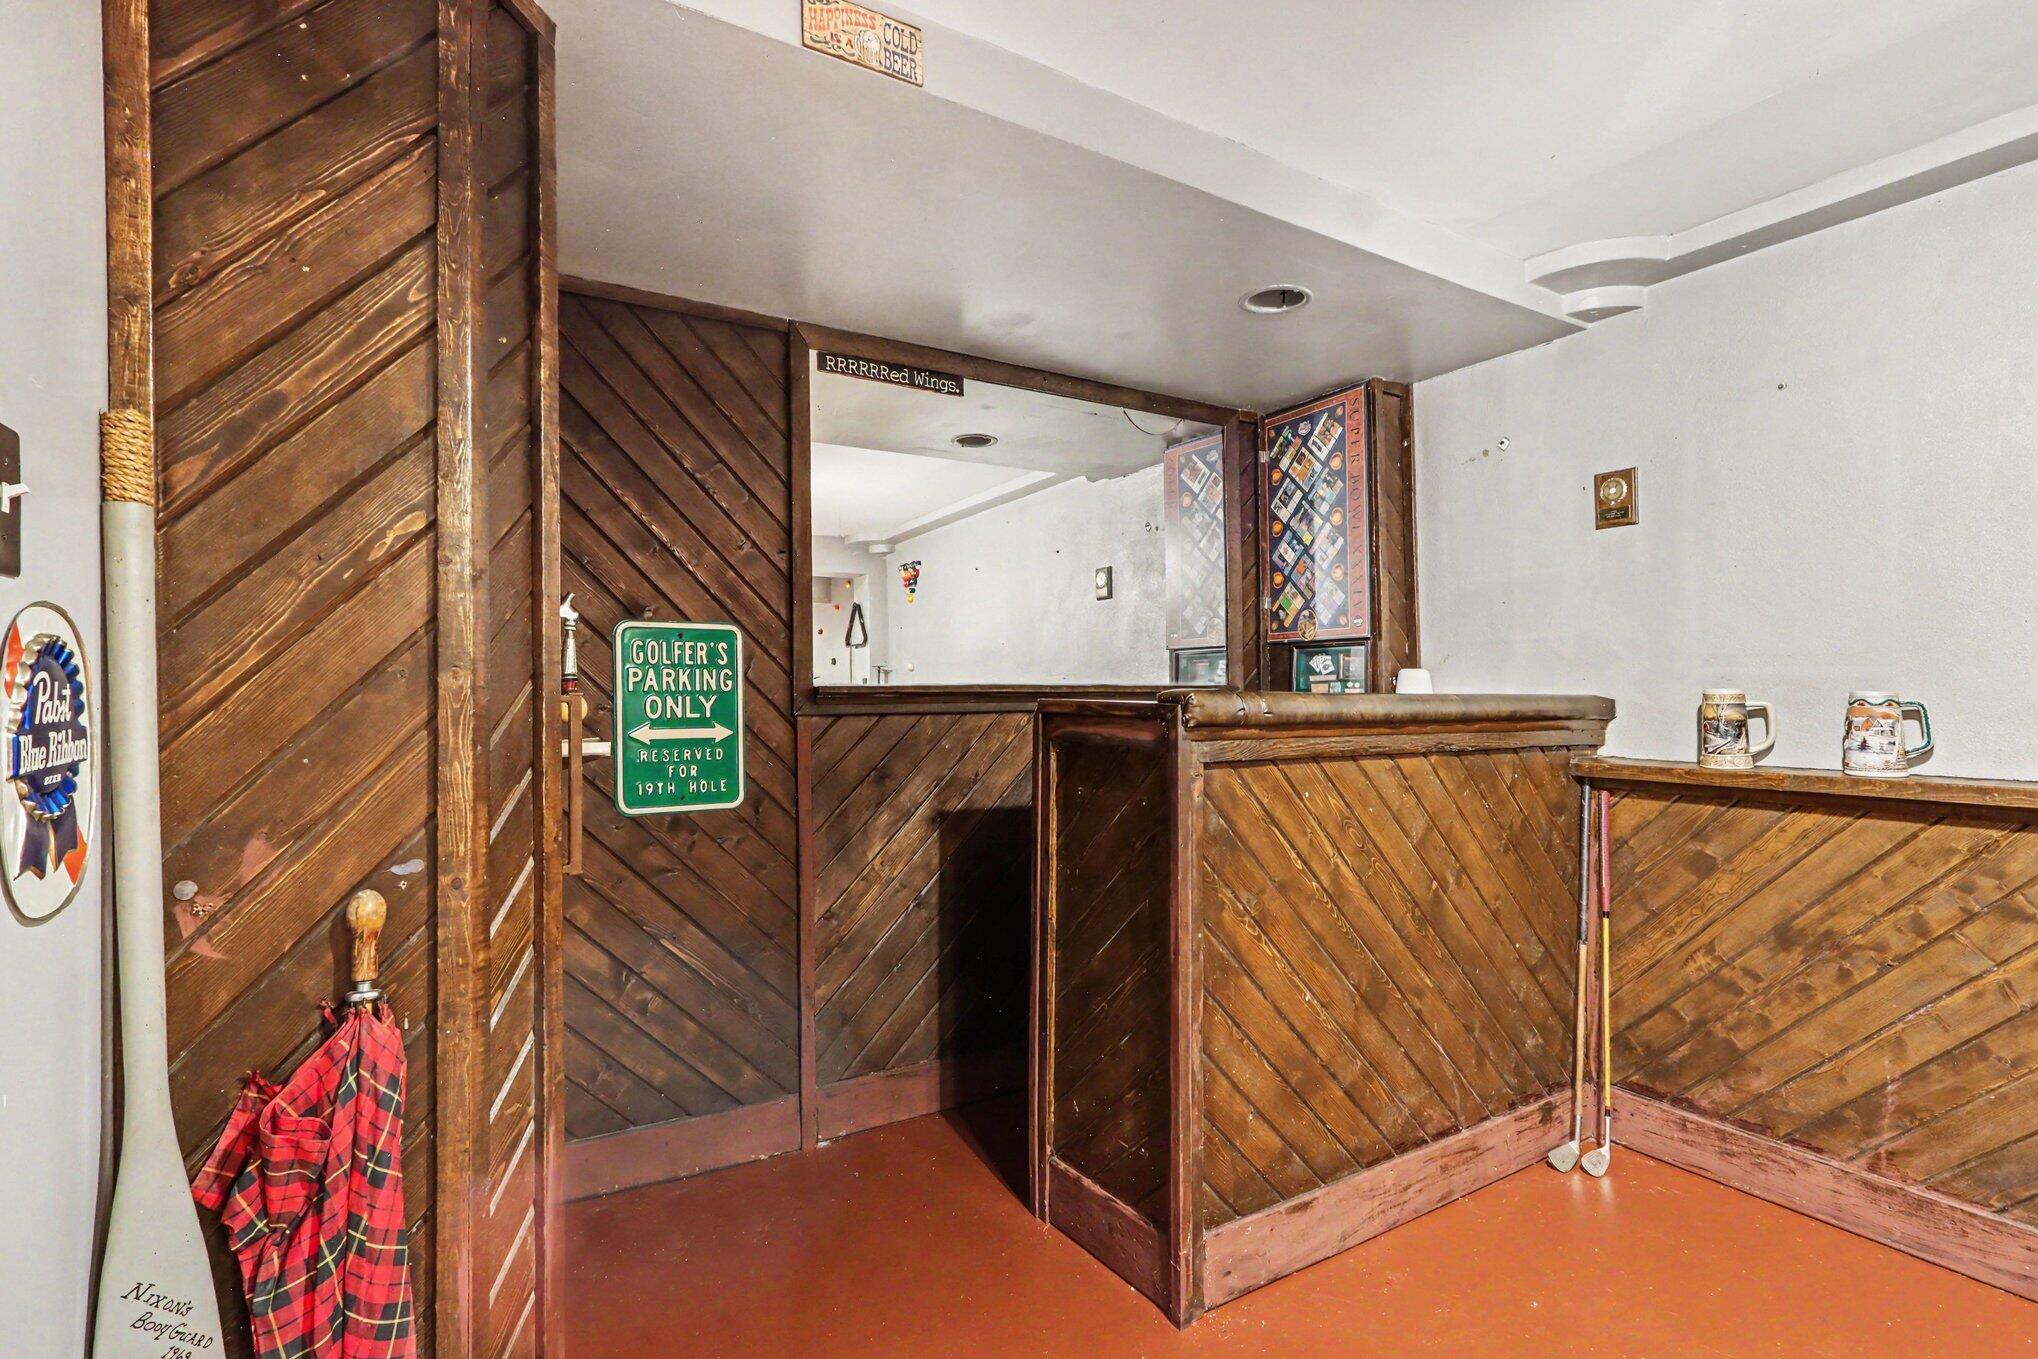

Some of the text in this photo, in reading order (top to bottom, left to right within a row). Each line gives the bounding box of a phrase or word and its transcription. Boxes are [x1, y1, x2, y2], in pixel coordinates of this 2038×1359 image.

[808, 6, 877, 31] HAPPINESS
[883, 22, 918, 56] COLD
[883, 48, 918, 82] BEER
[825, 355, 960, 393] RRRRRRed Wings.
[631, 639, 729, 666] GOLFER'S
[626, 666, 733, 692] PARKING
[32, 670, 72, 725] Pabst
[644, 694, 718, 720] ONLY
[18, 728, 88, 775] Blue Ribbon
[637, 748, 724, 763] RESERVED
[667, 765, 699, 779] FOR
[636, 779, 727, 796] 19TH HOLE
